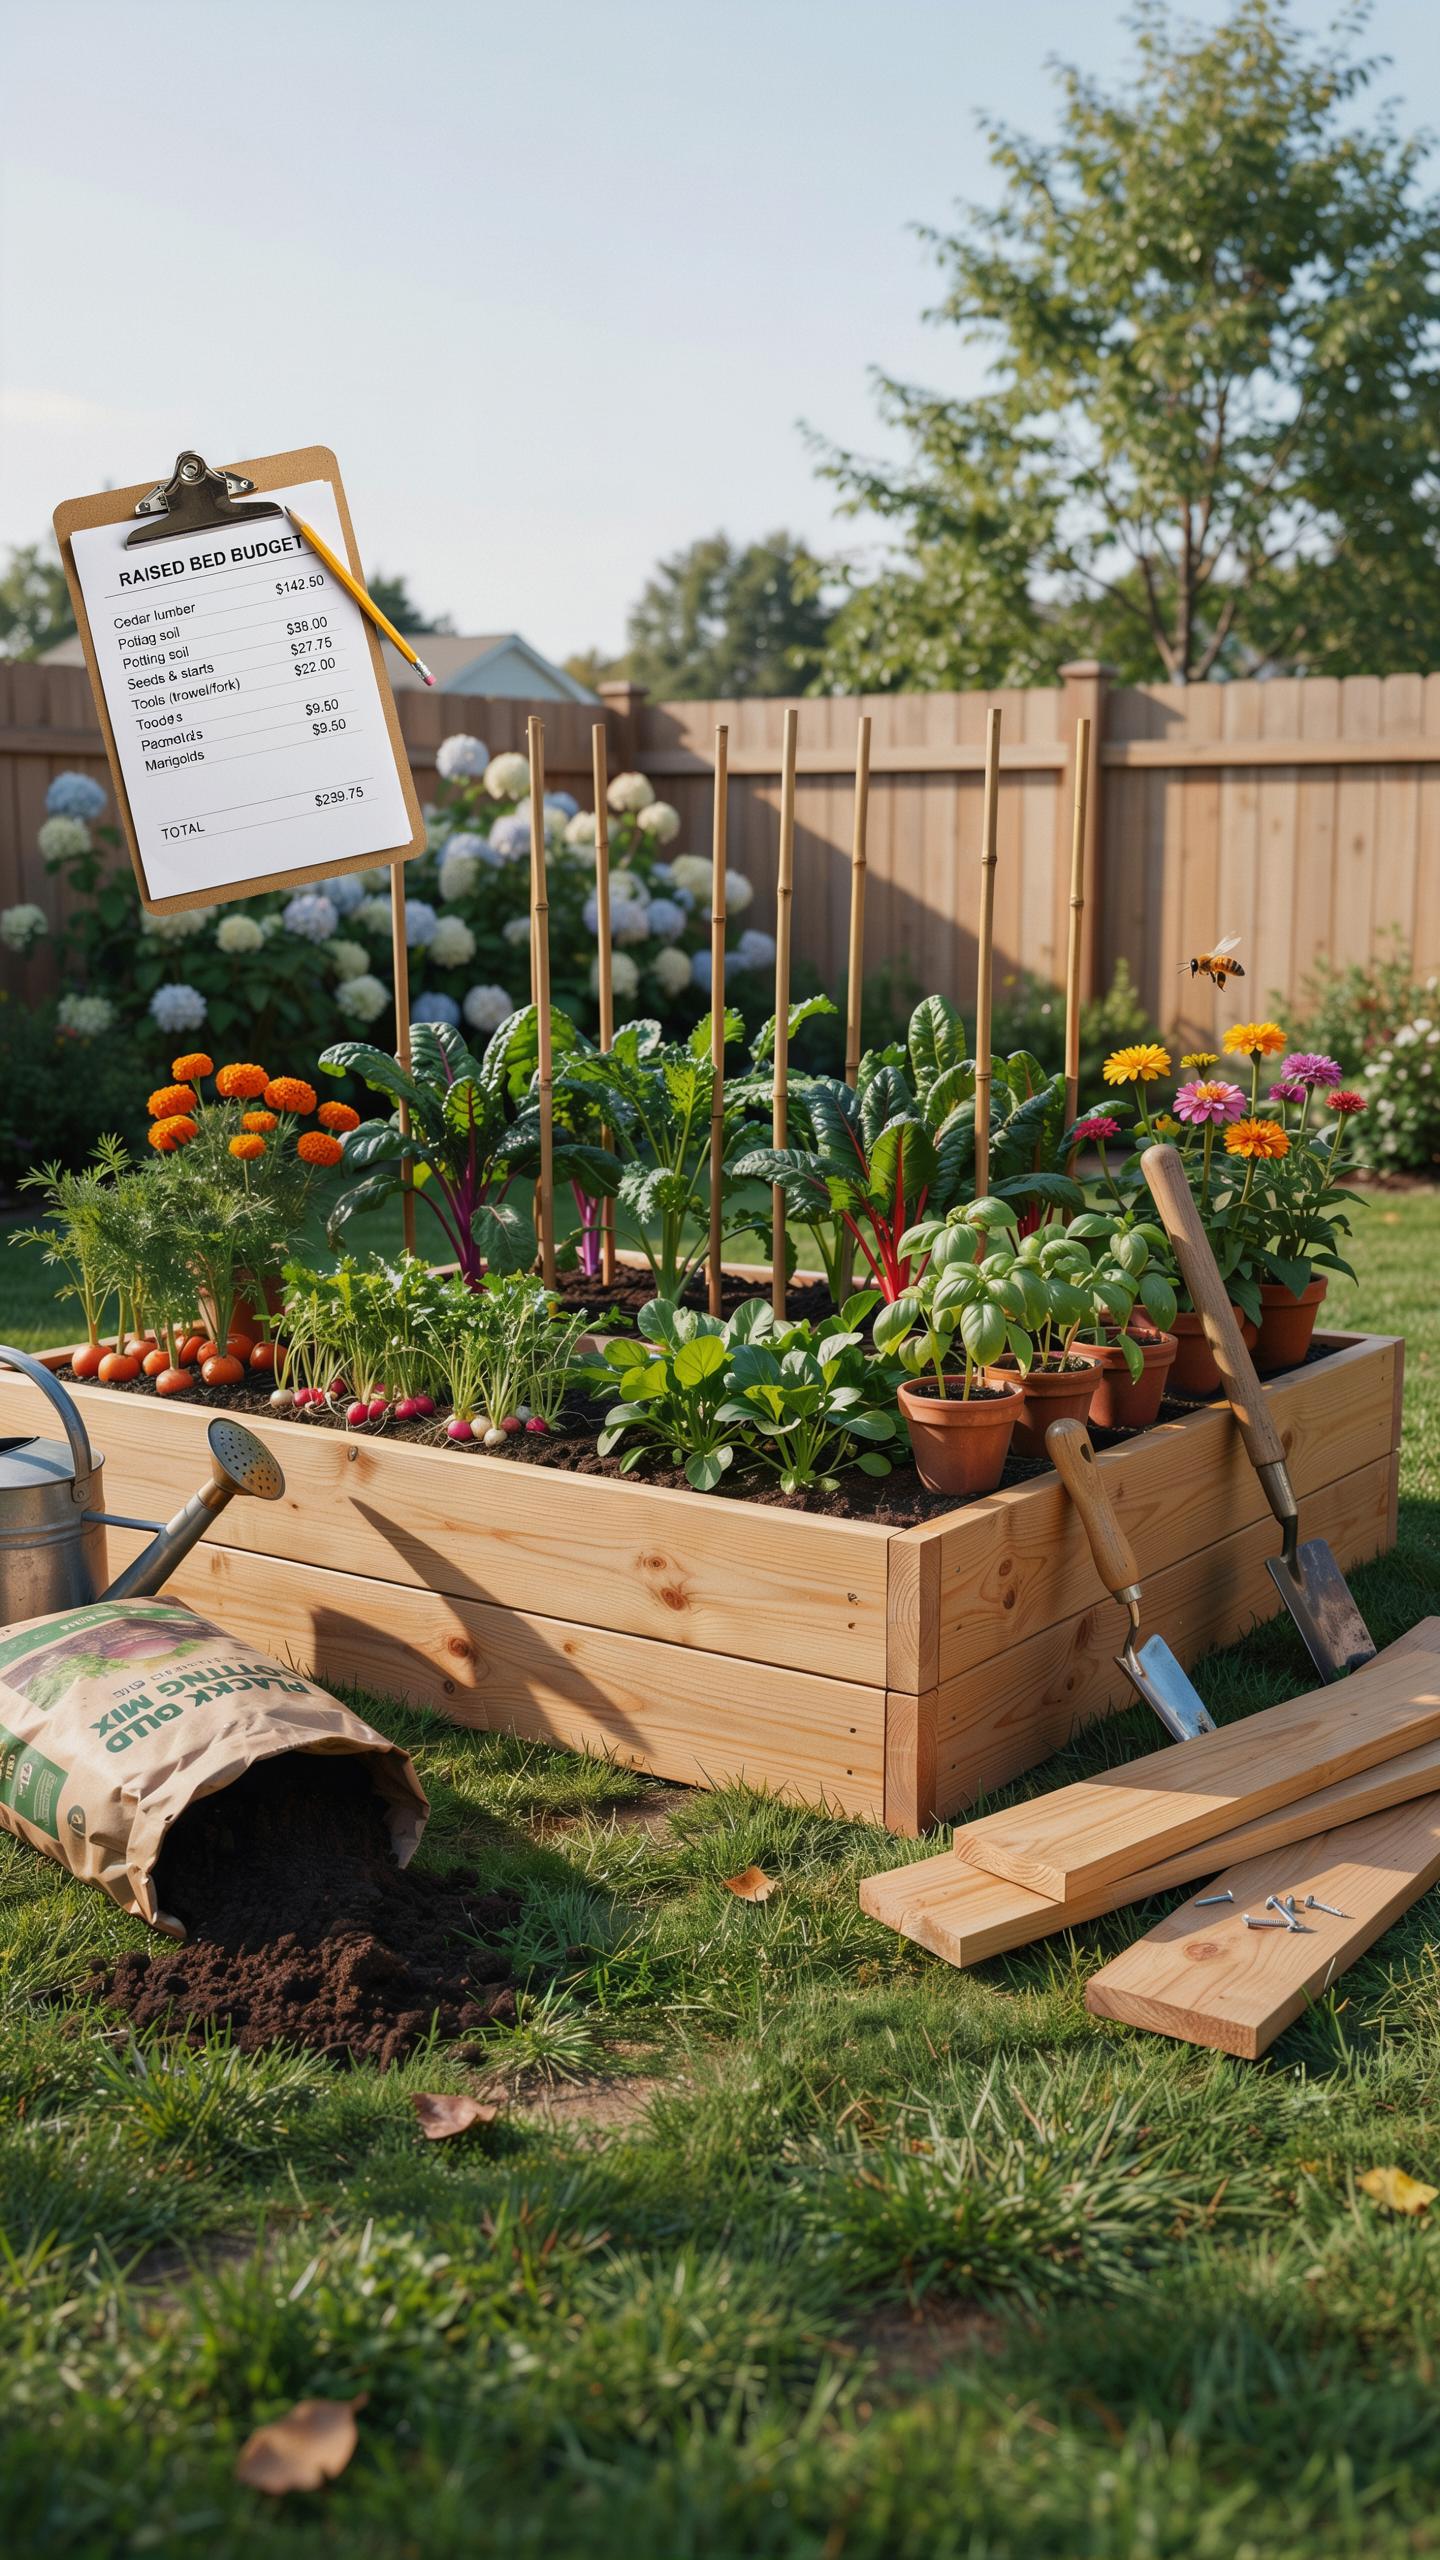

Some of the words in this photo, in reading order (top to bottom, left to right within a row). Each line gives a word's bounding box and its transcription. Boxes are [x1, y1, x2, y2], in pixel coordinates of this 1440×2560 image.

[119, 558, 184, 587] RAISED
[190, 550, 226, 571] BED
[231, 534, 304, 562] BUDGET
[275, 575, 325, 595] $142.50
[113, 611, 150, 629] Cedar
[154, 602, 195, 621] lumber
[287, 616, 328, 635] $38.00
[160, 627, 180, 641] soil
[290, 637, 332, 656] $27.75
[123, 651, 166, 670] Potting
[169, 647, 189, 660] soil
[295, 657, 336, 677] $22.00
[127, 672, 165, 690] Seeds
[169, 669, 178, 681] &
[132, 695, 166, 710] Tools
[169, 678, 241, 705] (trowel/fork)
[305, 699, 339, 716] $9.50
[312, 718, 347, 737] $9.50
[145, 750, 205, 771] Marigolds
[315, 786, 364, 807] $239.75
[161, 822, 205, 840] TOTAL
[89, 1693, 155, 1738] MIX
